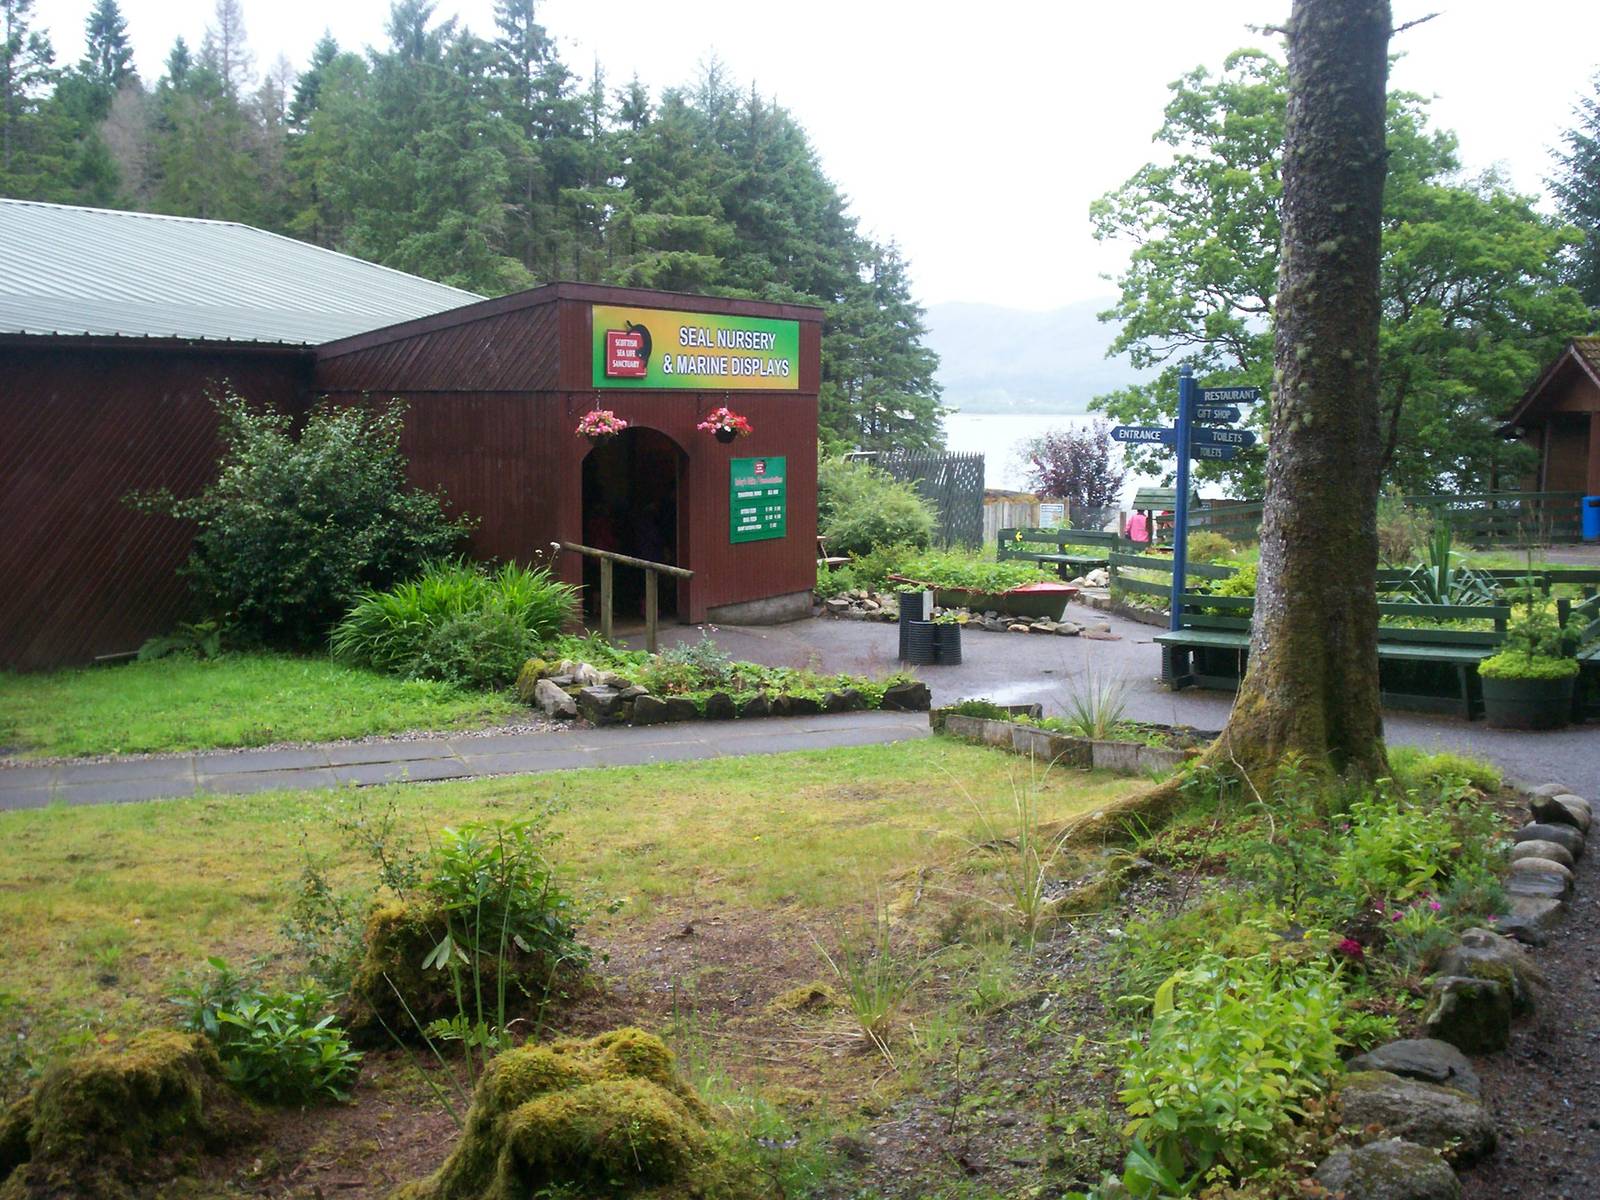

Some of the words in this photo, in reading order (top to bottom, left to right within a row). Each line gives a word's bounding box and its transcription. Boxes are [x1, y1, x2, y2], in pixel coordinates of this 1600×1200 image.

[679, 327, 714, 347] SEAL
[718, 329, 775, 350] NURSERY
[663, 354, 673, 374] &
[677, 355, 728, 375] MARINE
[732, 358, 789, 377] DISPLAYS
[1204, 390, 1255, 400] RESTAURANT
[1197, 409, 1211, 418] GIFT
[1214, 410, 1231, 418] SHOP
[1119, 429, 1161, 440] ENTRANCE
[1212, 432, 1242, 442] TOILETS
